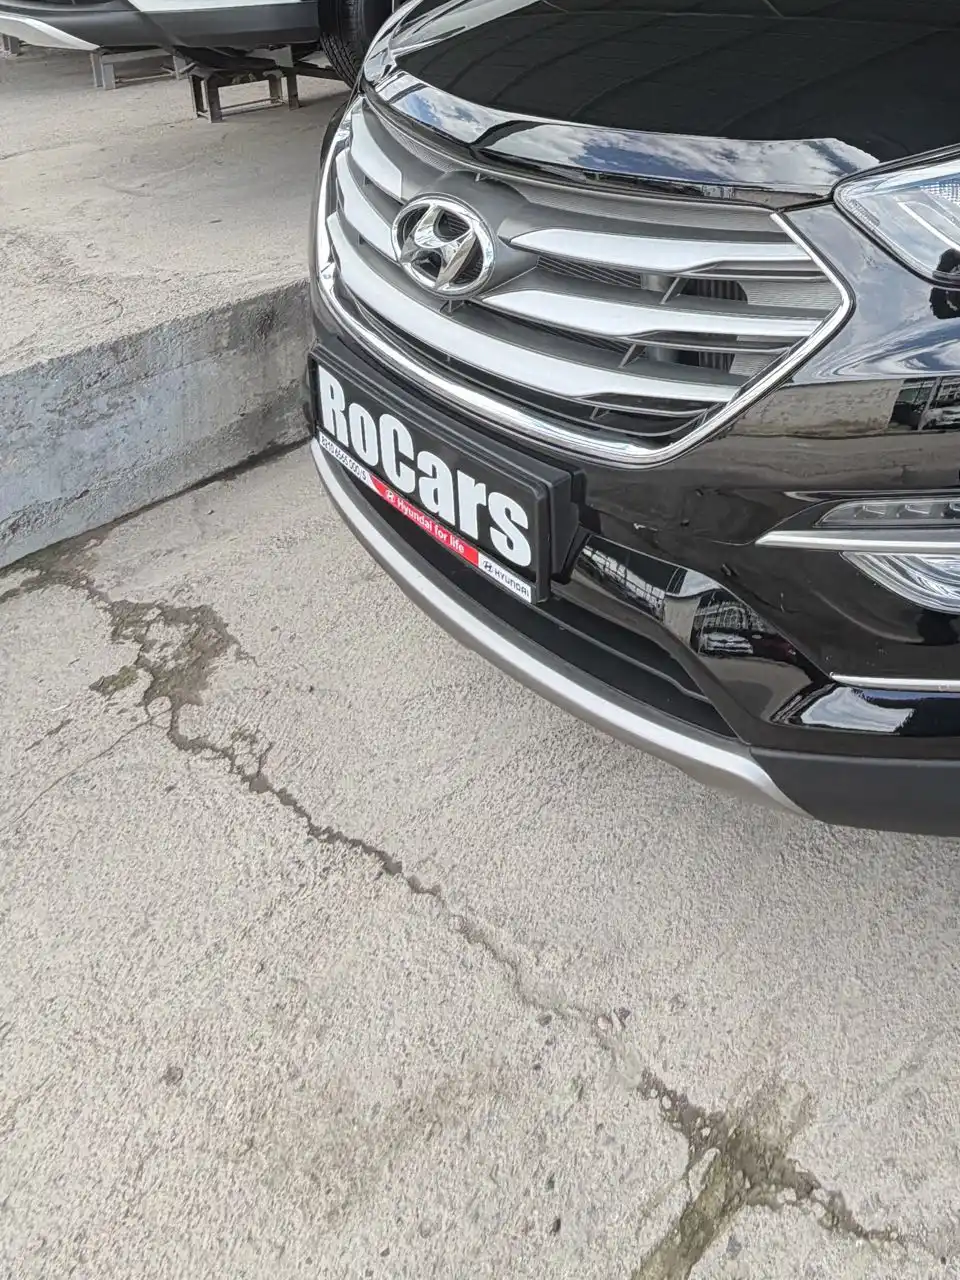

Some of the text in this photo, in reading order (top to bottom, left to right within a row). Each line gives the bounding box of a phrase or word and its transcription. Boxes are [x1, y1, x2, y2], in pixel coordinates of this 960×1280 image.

[318, 364, 532, 567] RoCars
[397, 496, 465, 554] Hyundai for life
[494, 568, 530, 598] HYUNDAI
